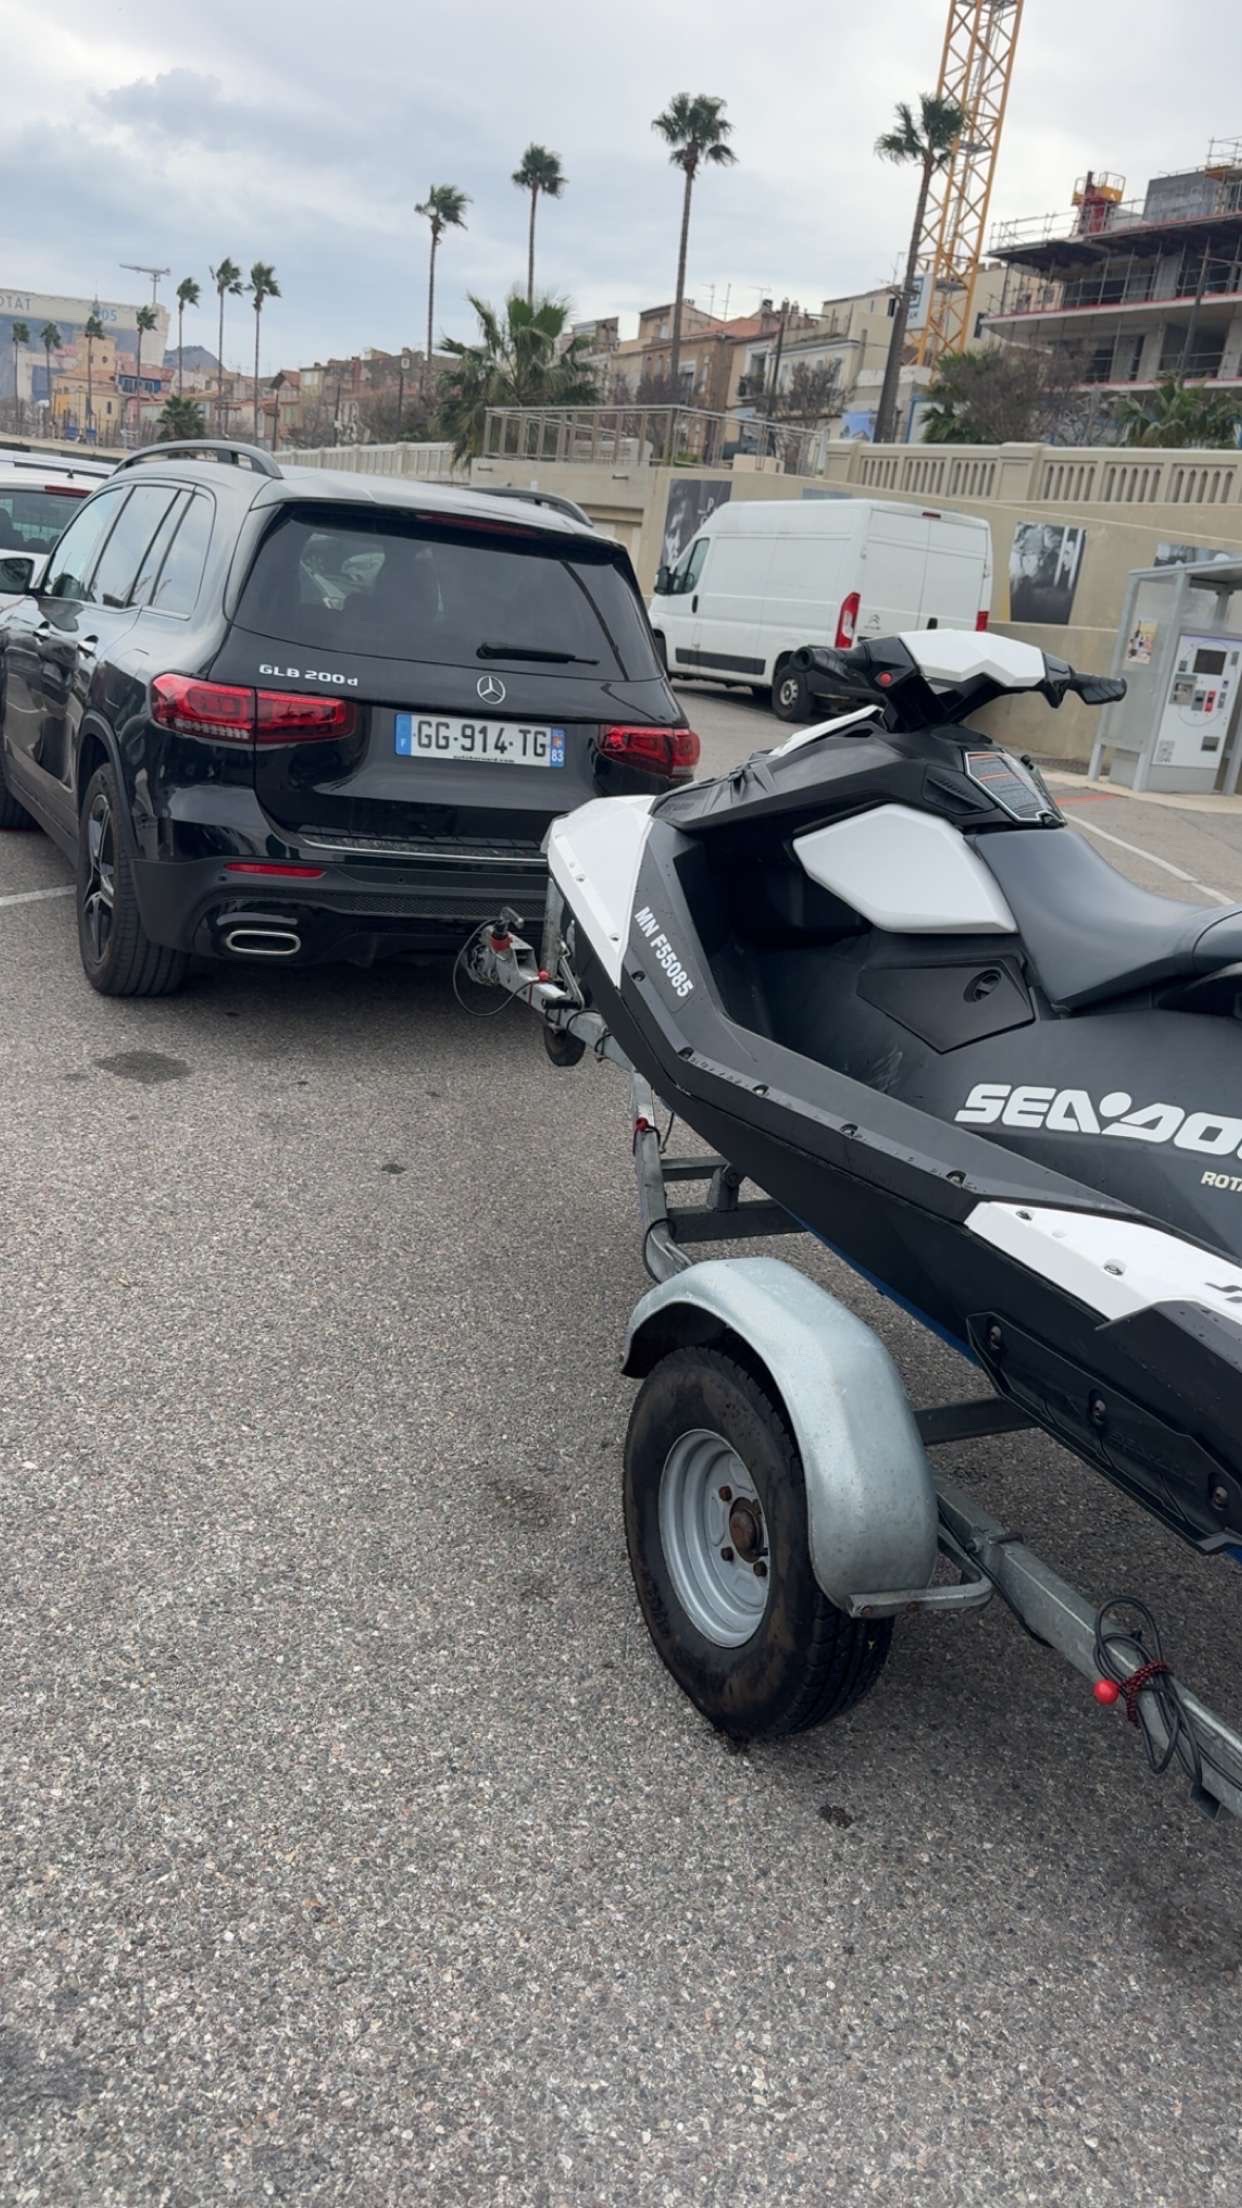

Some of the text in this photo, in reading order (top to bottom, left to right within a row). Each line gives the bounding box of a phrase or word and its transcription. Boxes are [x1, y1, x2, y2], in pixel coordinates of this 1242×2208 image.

[259, 663, 358, 687] GLB 200d
[551, 750, 564, 763] 83
[634, 906, 694, 997] MN F55085
